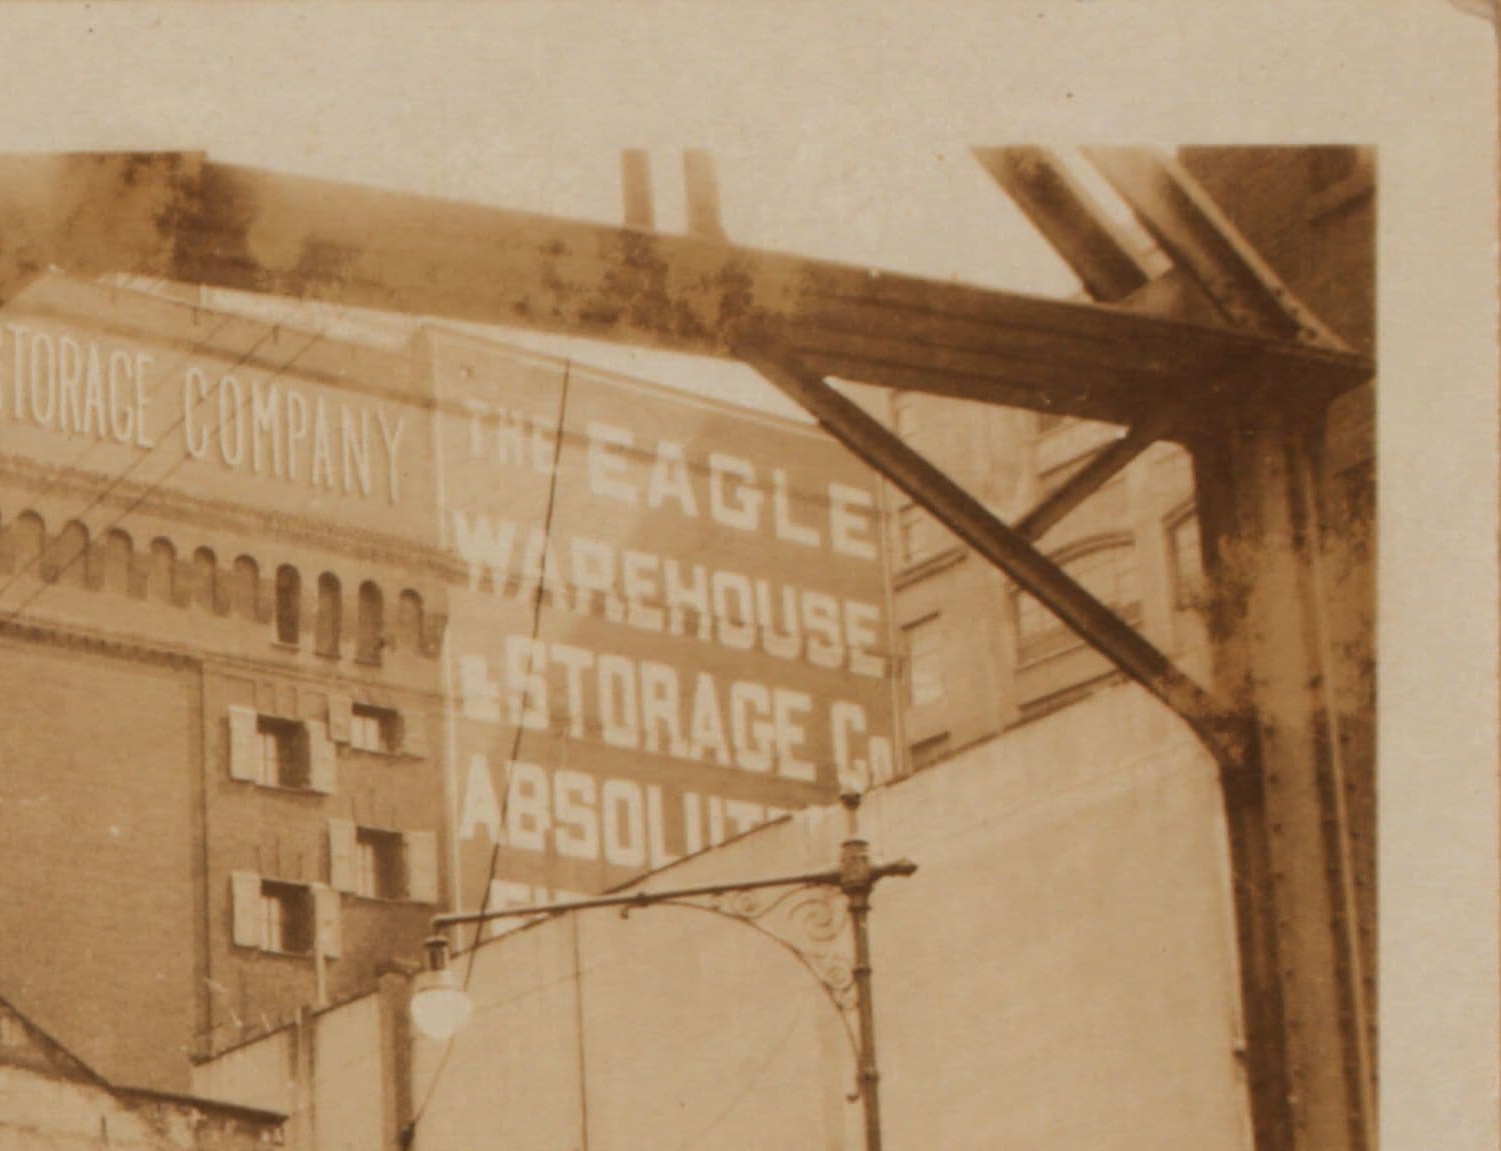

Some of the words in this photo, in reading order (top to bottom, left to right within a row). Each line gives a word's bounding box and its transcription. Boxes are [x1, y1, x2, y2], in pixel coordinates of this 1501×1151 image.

[184, 365, 405, 502] COMPANY
[464, 396, 557, 477] THE
[586, 418, 878, 561] EAGLE
[451, 508, 887, 680] WAREHOUSE
